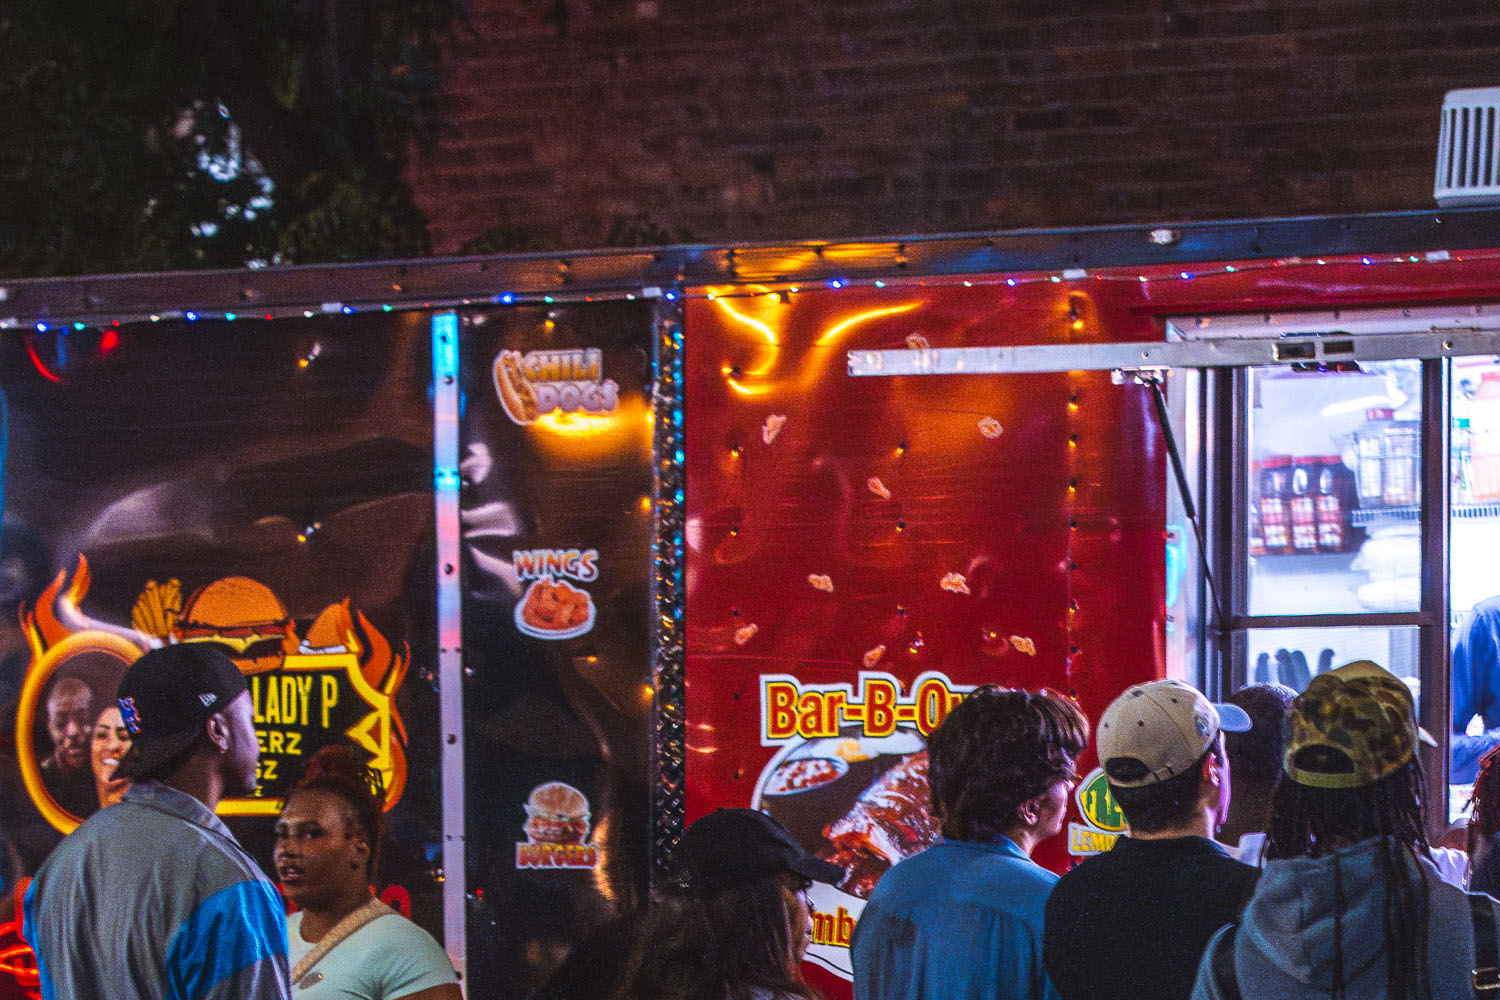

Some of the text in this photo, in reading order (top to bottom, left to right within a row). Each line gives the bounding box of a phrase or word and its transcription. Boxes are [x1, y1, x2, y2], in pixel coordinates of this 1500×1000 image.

[513, 549, 599, 582] WINGS
[252, 674, 339, 729] LADY P
